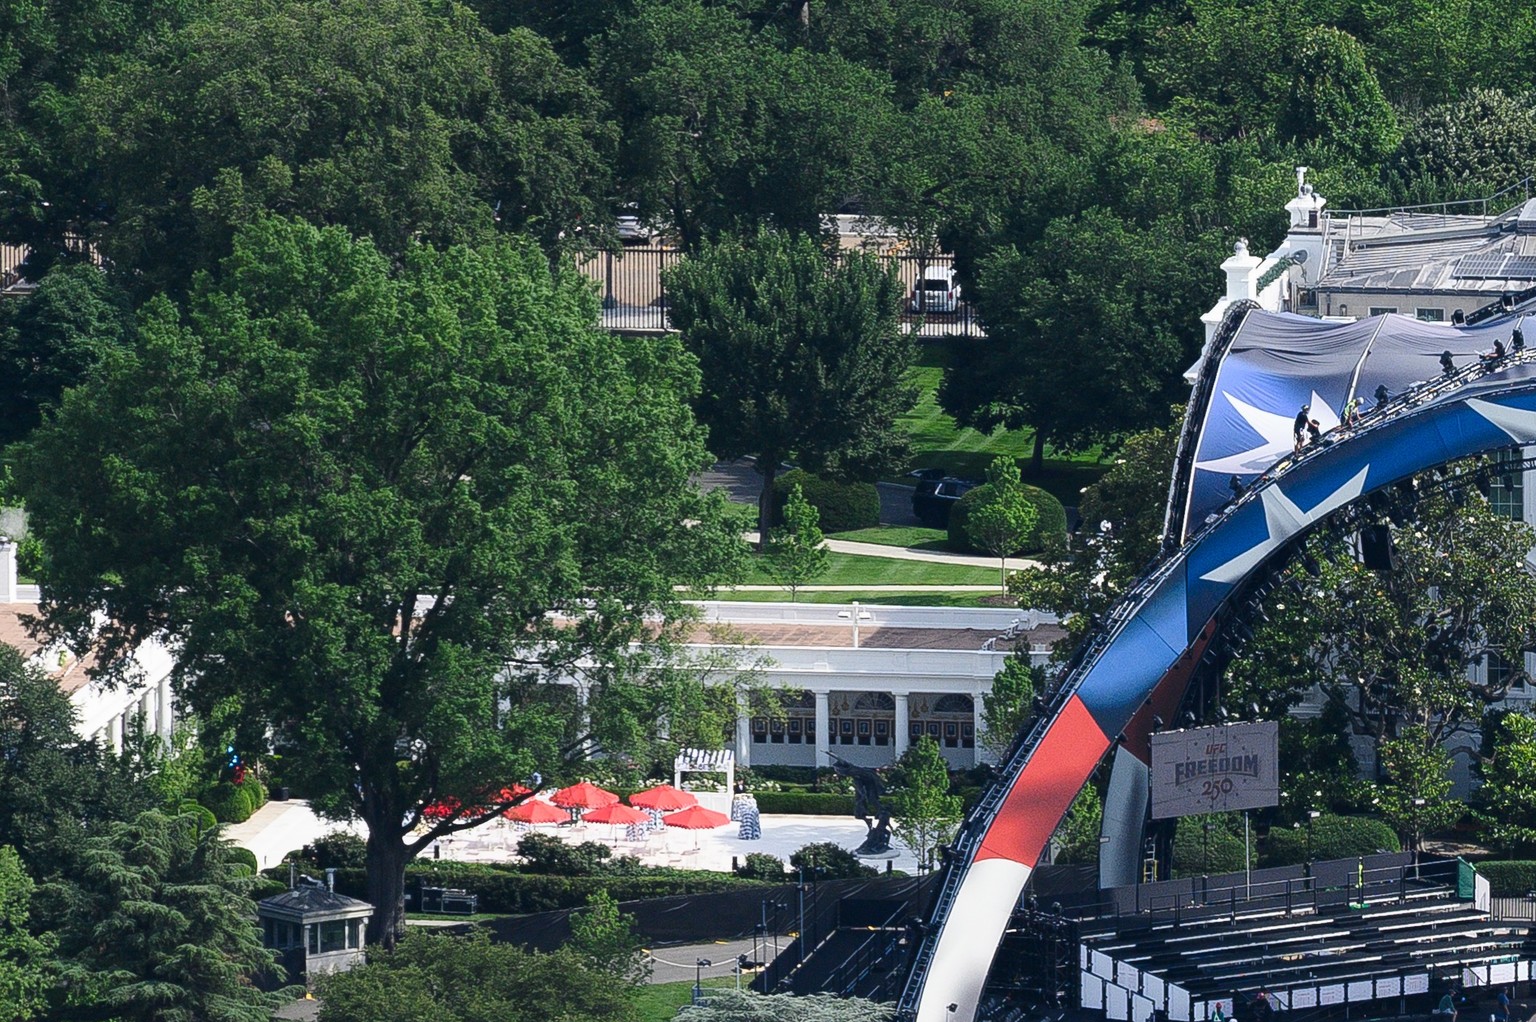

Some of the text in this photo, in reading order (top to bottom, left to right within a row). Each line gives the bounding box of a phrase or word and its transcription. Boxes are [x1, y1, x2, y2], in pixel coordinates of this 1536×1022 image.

[1205, 743, 1227, 755] UFC
[1175, 754, 1259, 787] FREEDOM
[1201, 778, 1233, 801] 250
